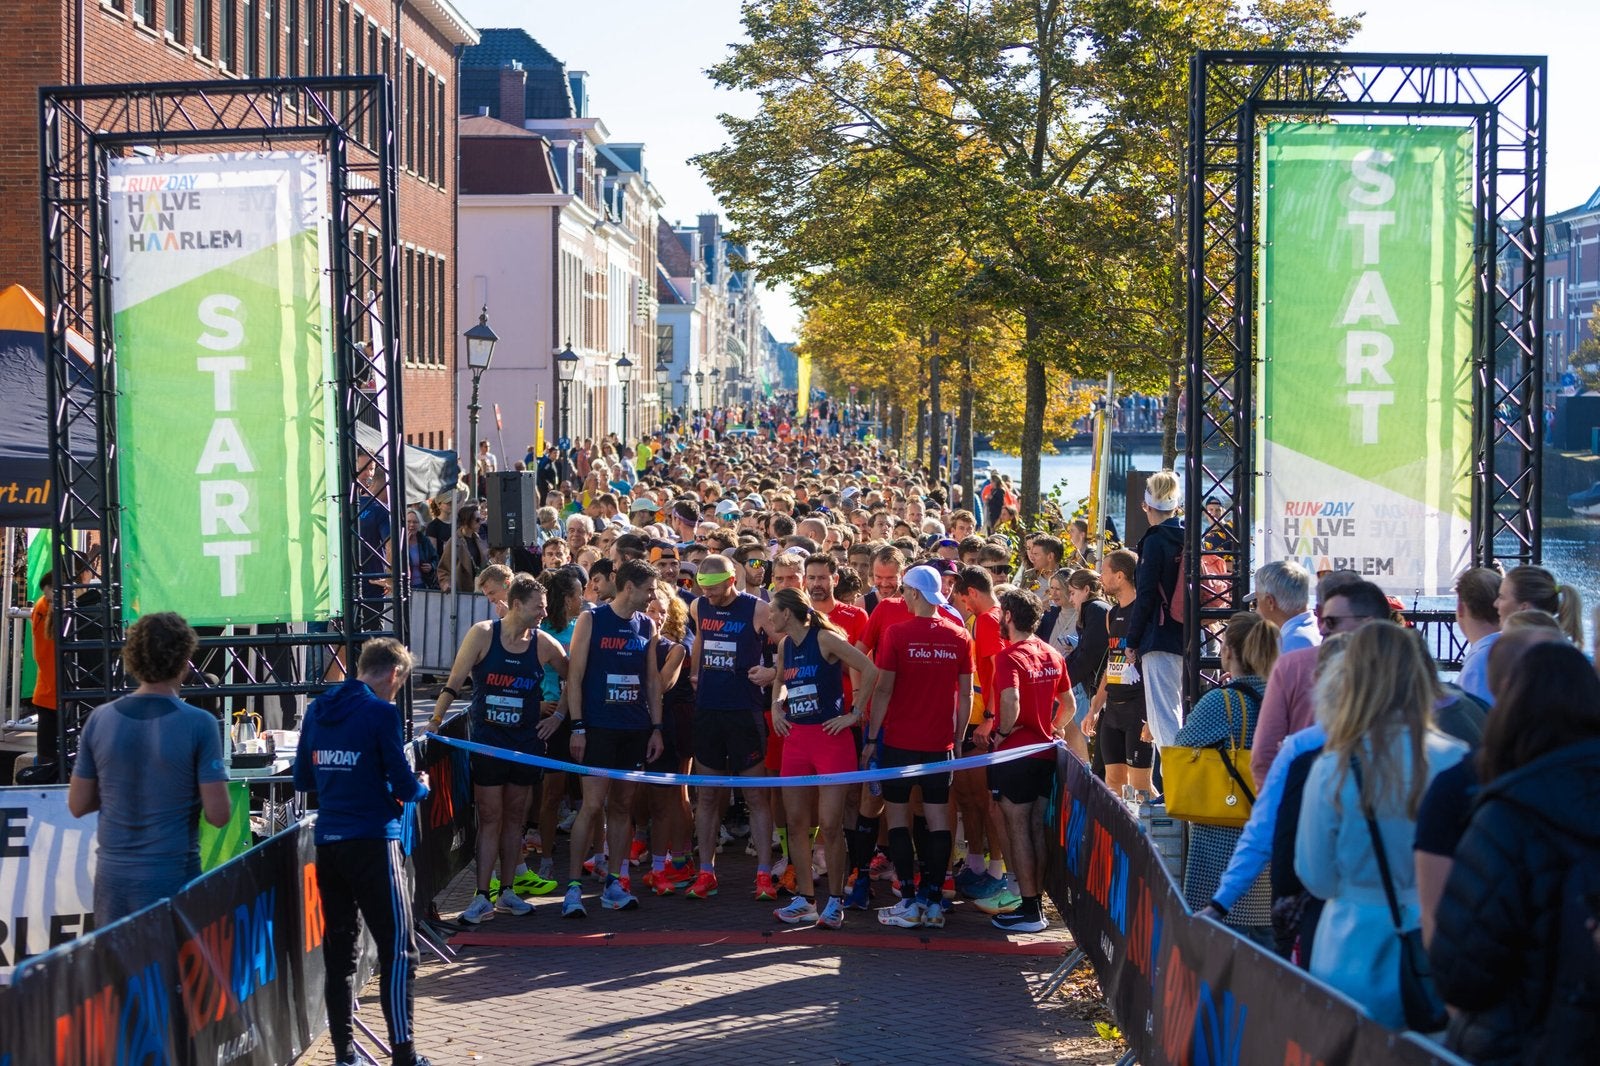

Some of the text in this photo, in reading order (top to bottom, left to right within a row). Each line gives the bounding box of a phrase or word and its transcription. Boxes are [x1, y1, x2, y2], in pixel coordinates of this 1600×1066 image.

[127, 191, 201, 212] HALVE
[129, 212, 175, 232] VAN
[129, 229, 242, 252] HAARLEM
[1342, 149, 1400, 444] START
[195, 293, 255, 597] START
[1284, 518, 1355, 537] HALVE
[1284, 537, 1329, 555] VAN
[704, 655, 734, 667] 11414
[908, 648, 957, 660] Toko Nina
[608, 688, 639, 700] 11413
[789, 699, 819, 714] 11421
[486, 709, 521, 723] 11410
